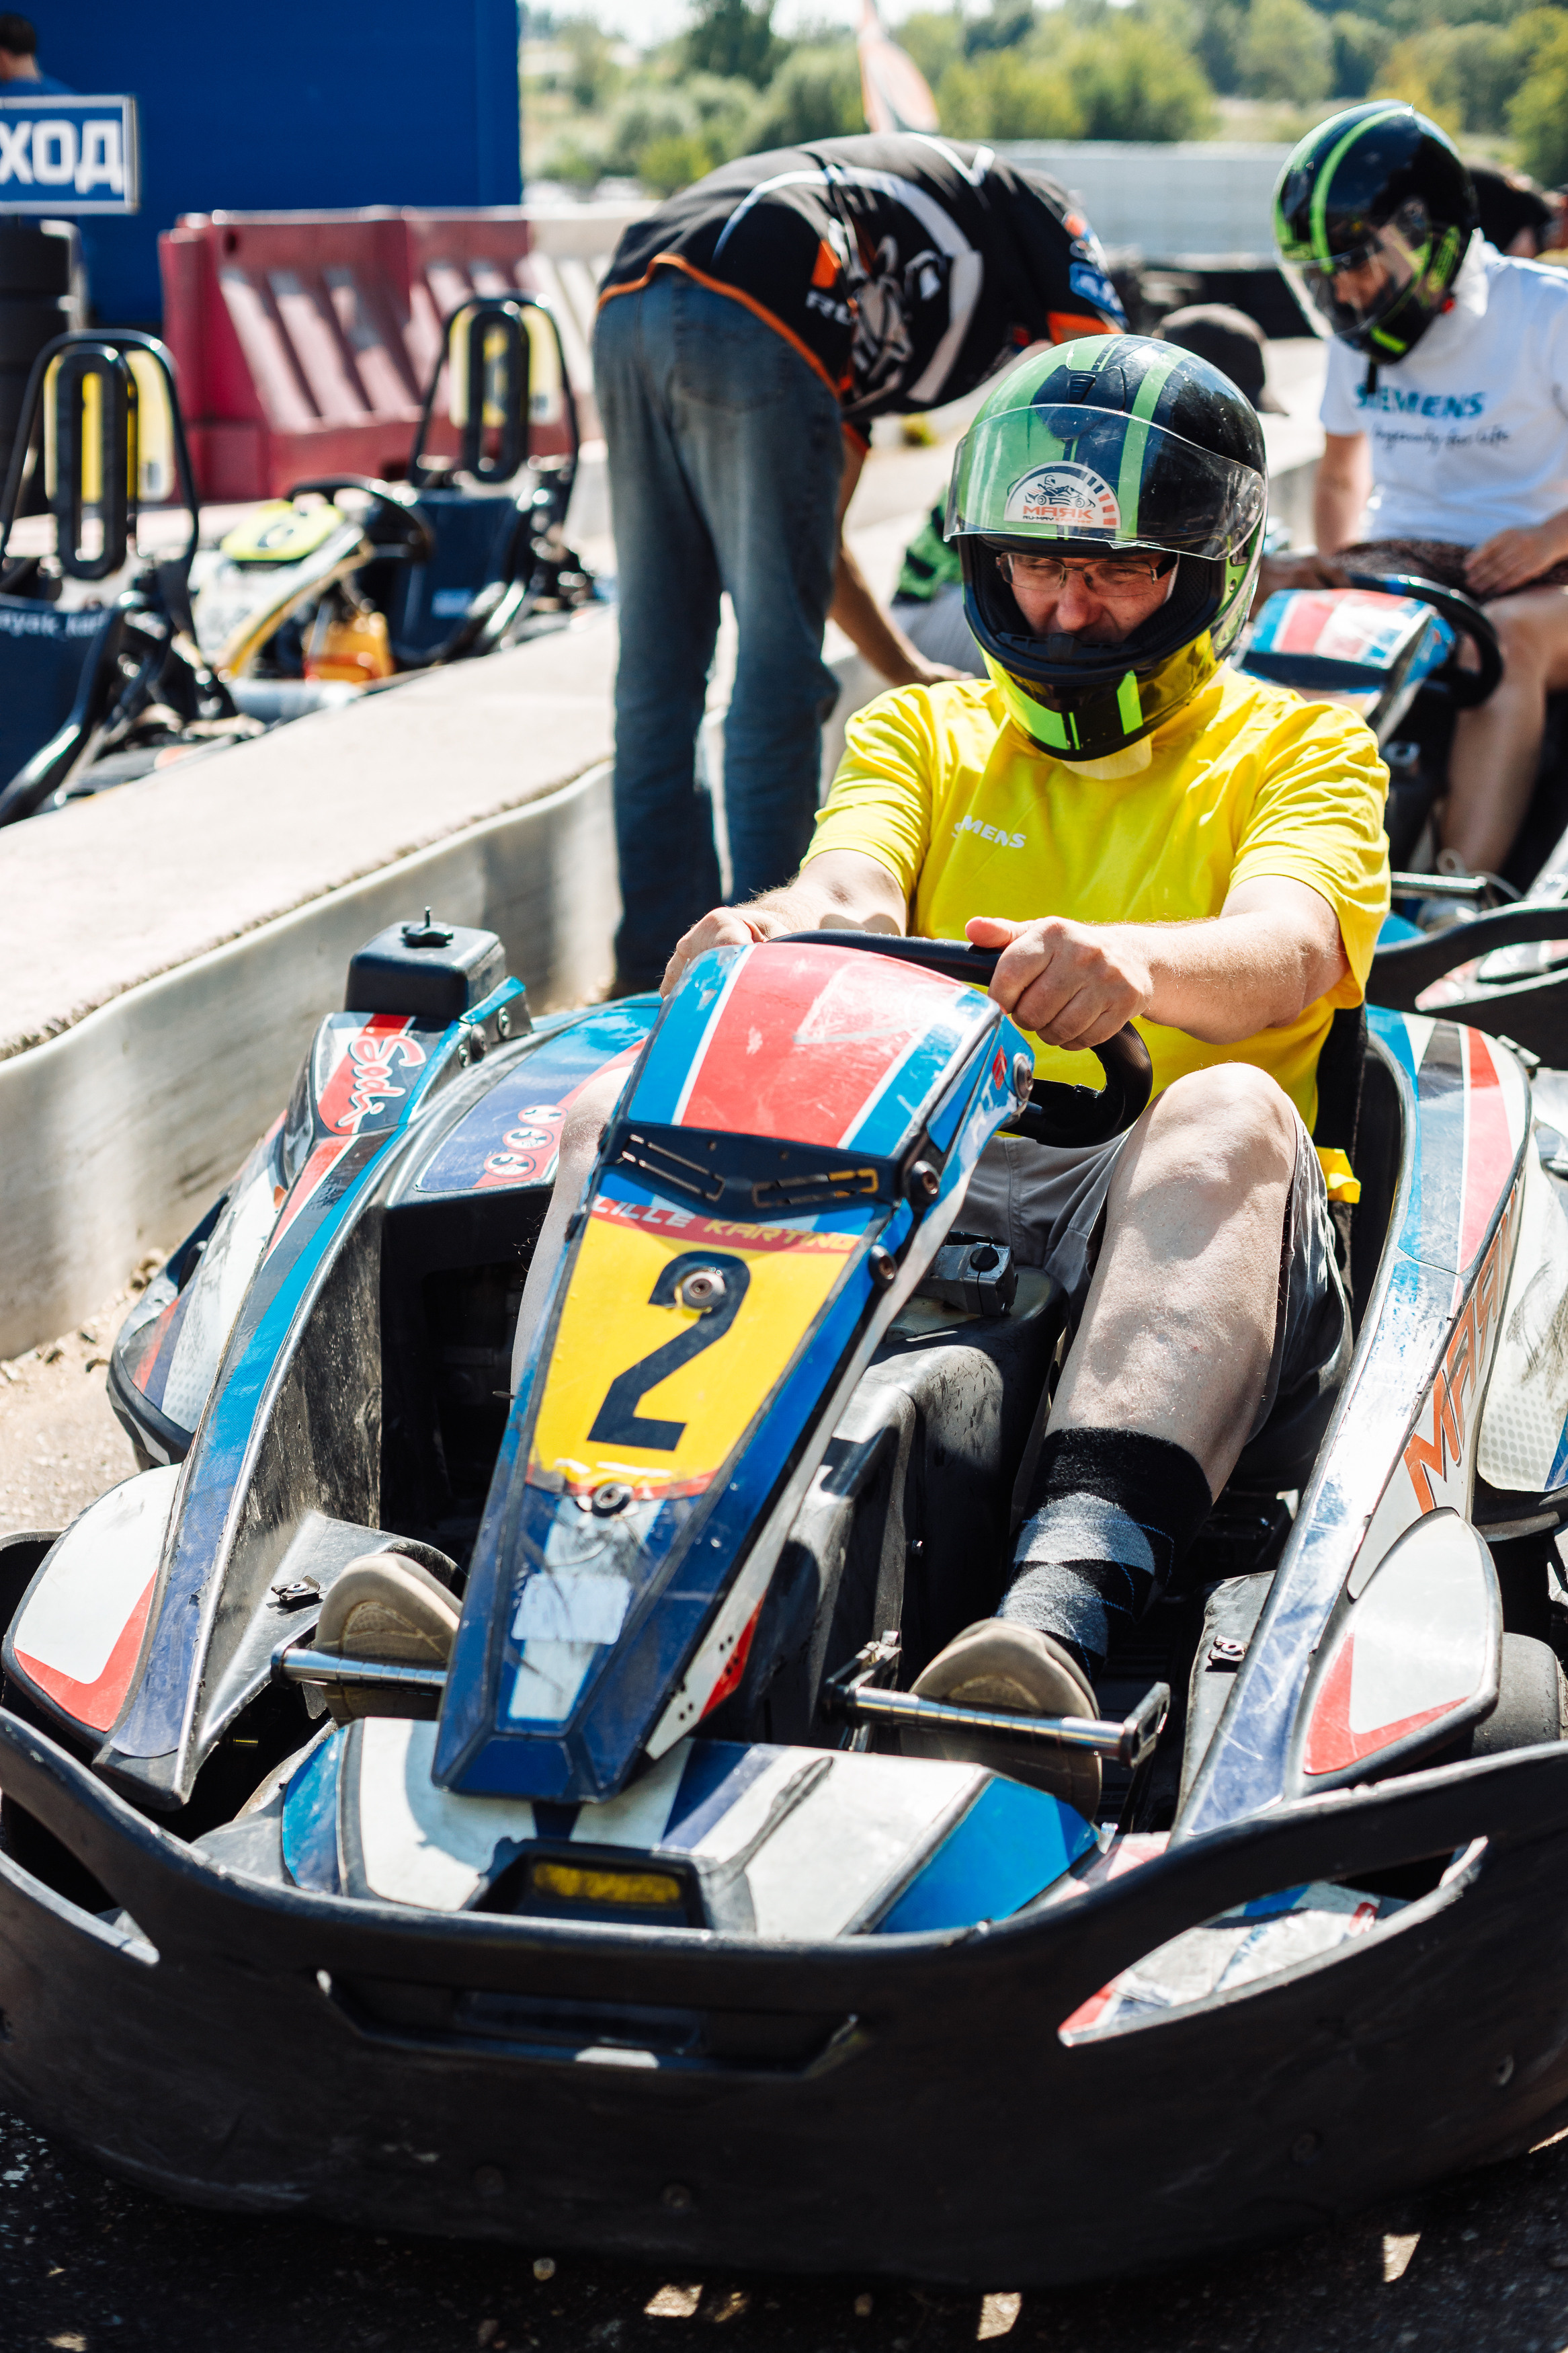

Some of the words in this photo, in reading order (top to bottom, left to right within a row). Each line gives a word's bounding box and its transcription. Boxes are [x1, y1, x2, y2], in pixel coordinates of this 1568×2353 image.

[0, 119, 124, 195] ХОД
[1023, 505, 1094, 520] МАЯК
[337, 1033, 426, 1127] Sodi
[591, 1194, 696, 1228] LILLE
[702, 1218, 861, 1250] KARTING
[587, 1250, 751, 1451] 2
